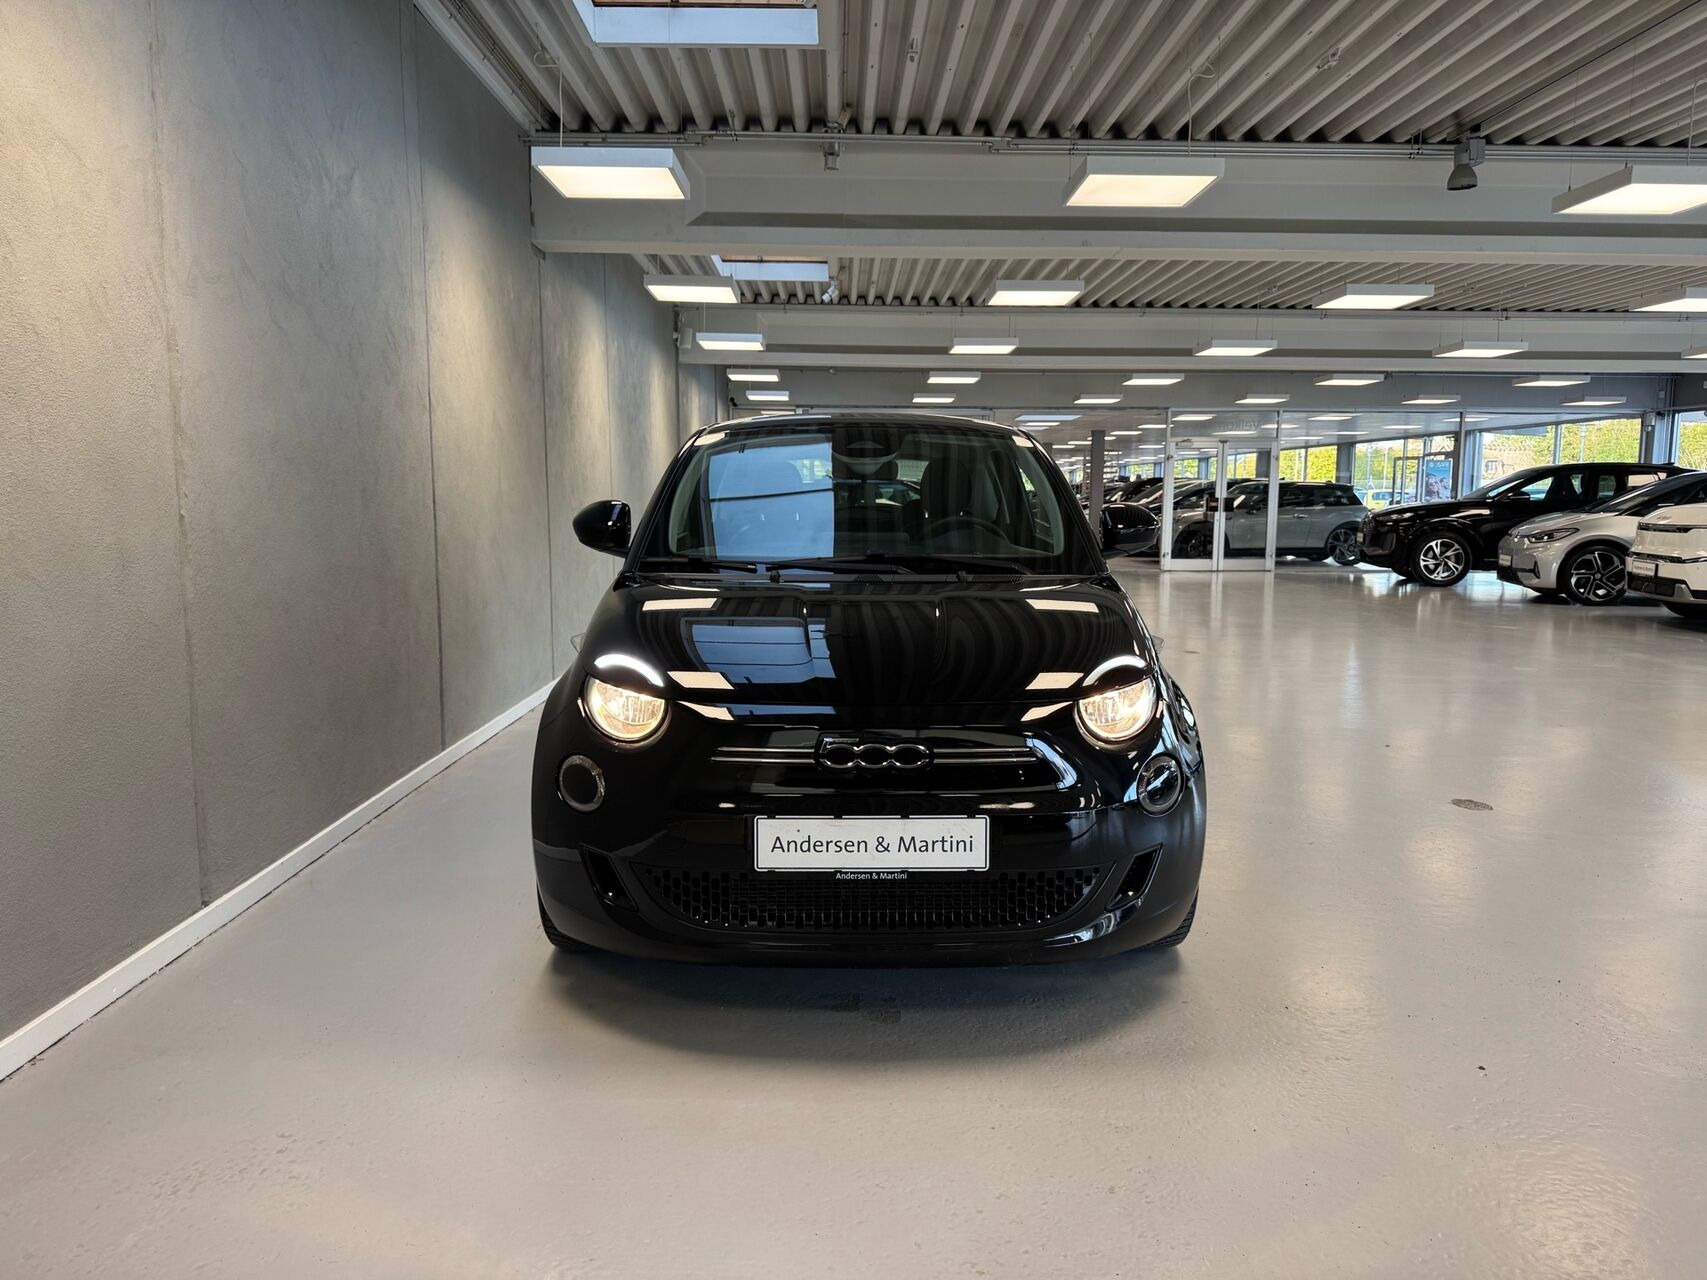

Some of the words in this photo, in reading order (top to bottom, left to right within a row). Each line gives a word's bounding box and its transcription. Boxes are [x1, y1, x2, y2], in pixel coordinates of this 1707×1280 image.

[819, 737, 930, 768] 500
[770, 834, 868, 854] Andersen
[875, 835, 891, 854] &
[897, 834, 974, 854] Martini
[835, 872, 871, 880] Andersen
[872, 872, 878, 880] &
[879, 872, 907, 880] Martini
